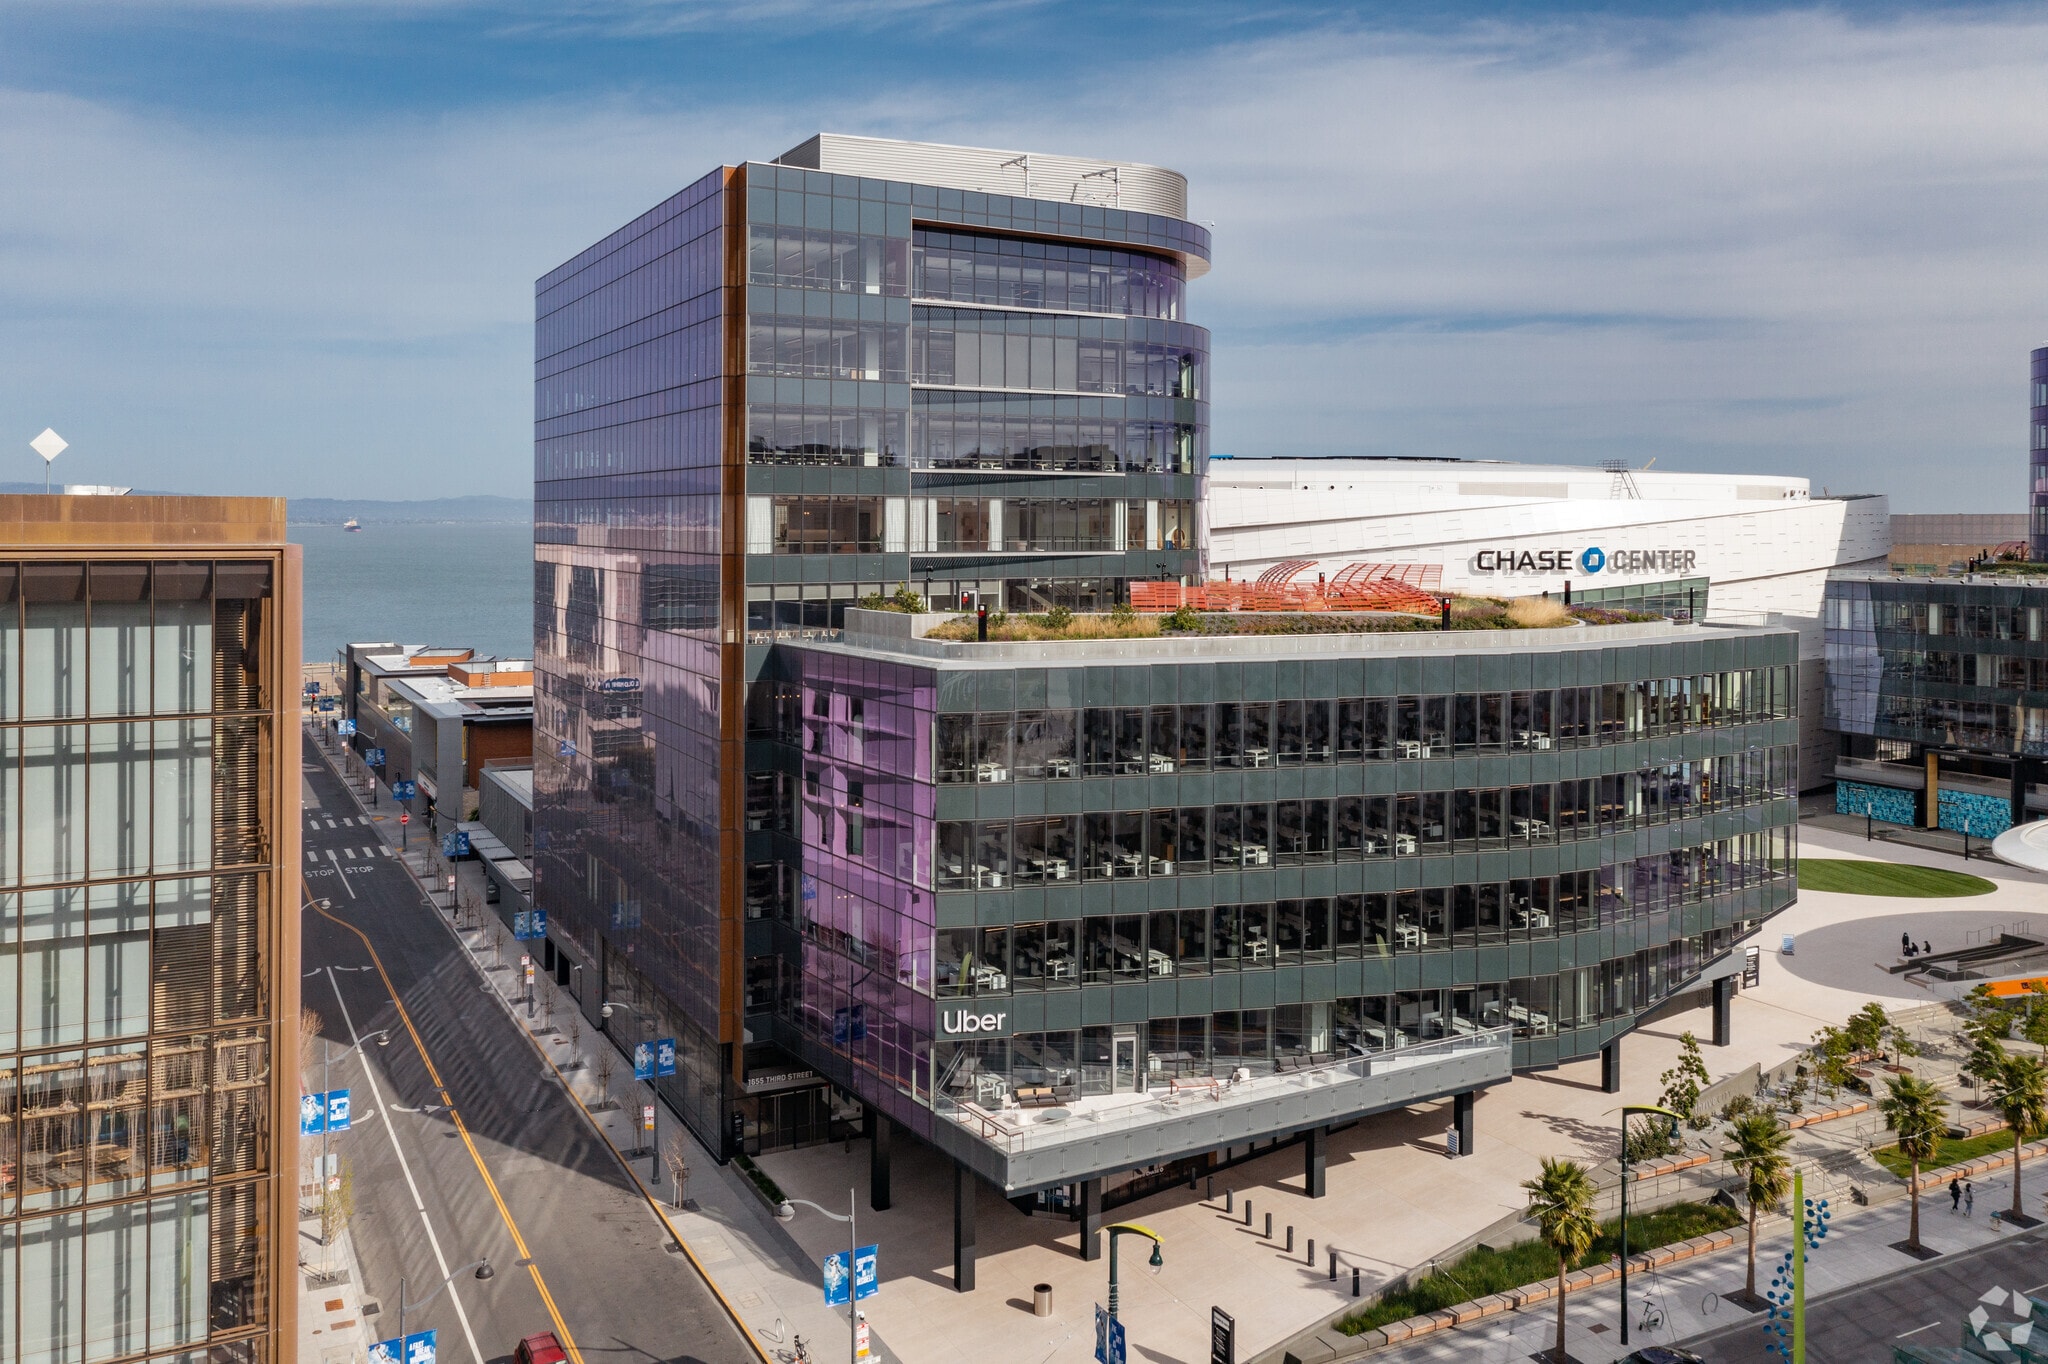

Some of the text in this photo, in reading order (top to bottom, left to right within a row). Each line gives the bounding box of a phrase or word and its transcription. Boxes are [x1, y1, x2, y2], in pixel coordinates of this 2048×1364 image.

[1477, 549, 1696, 571] CHASE CENTER
[304, 868, 335, 878] STOP
[345, 865, 374, 874] STOP
[943, 1009, 1007, 1034] Uber
[748, 1070, 813, 1087] 1655 THIRD STREET
